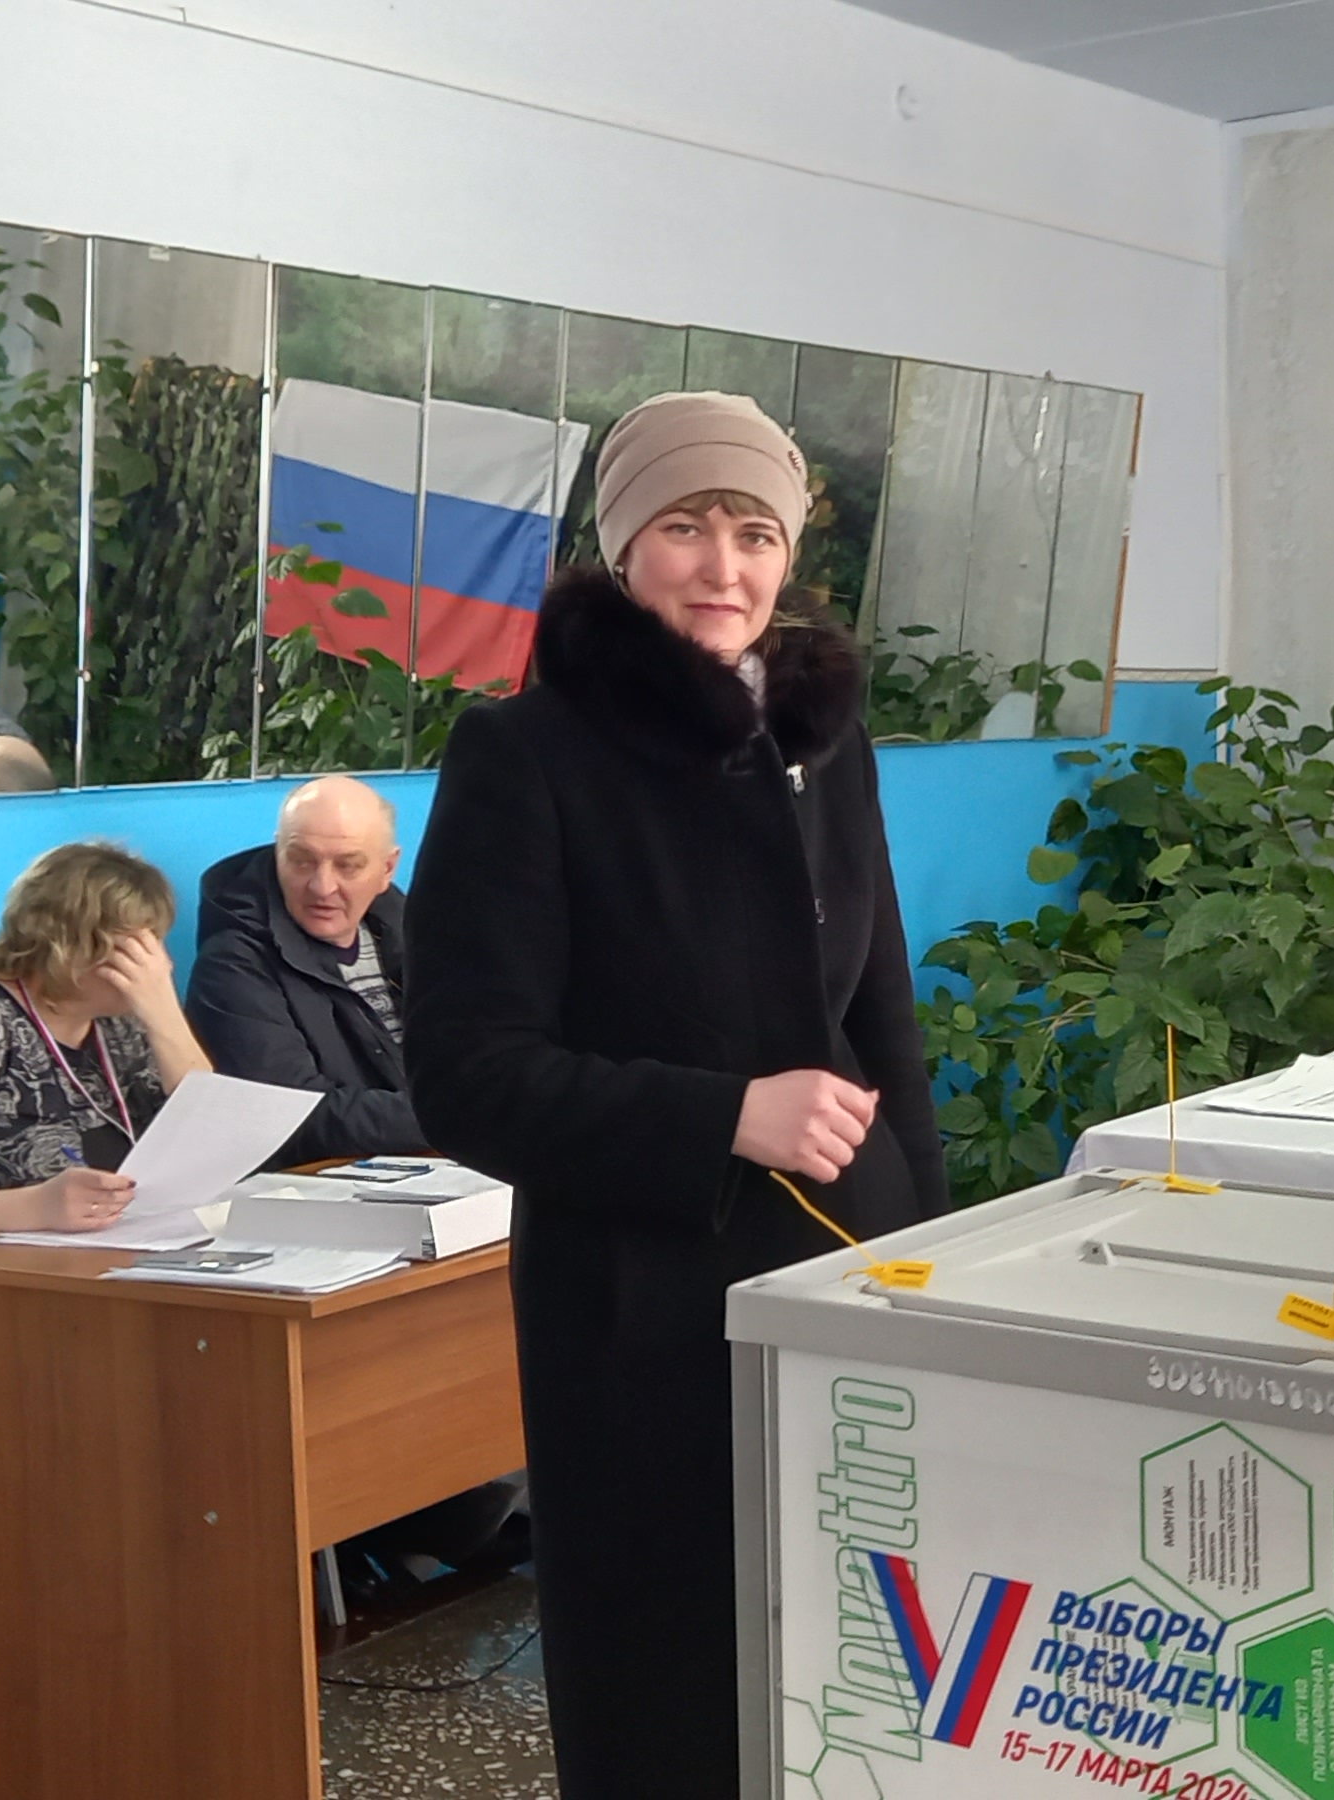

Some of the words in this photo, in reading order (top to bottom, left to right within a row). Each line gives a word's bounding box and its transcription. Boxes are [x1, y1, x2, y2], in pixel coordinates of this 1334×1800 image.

[1048, 1590, 1230, 1656] ВЫБОРЫ
[1030, 1637, 1285, 1722] ПРЕЗИДЕНТА
[1012, 1684, 1173, 1750] РОССИИ
[1074, 1747, 1174, 1797] МАРТА
